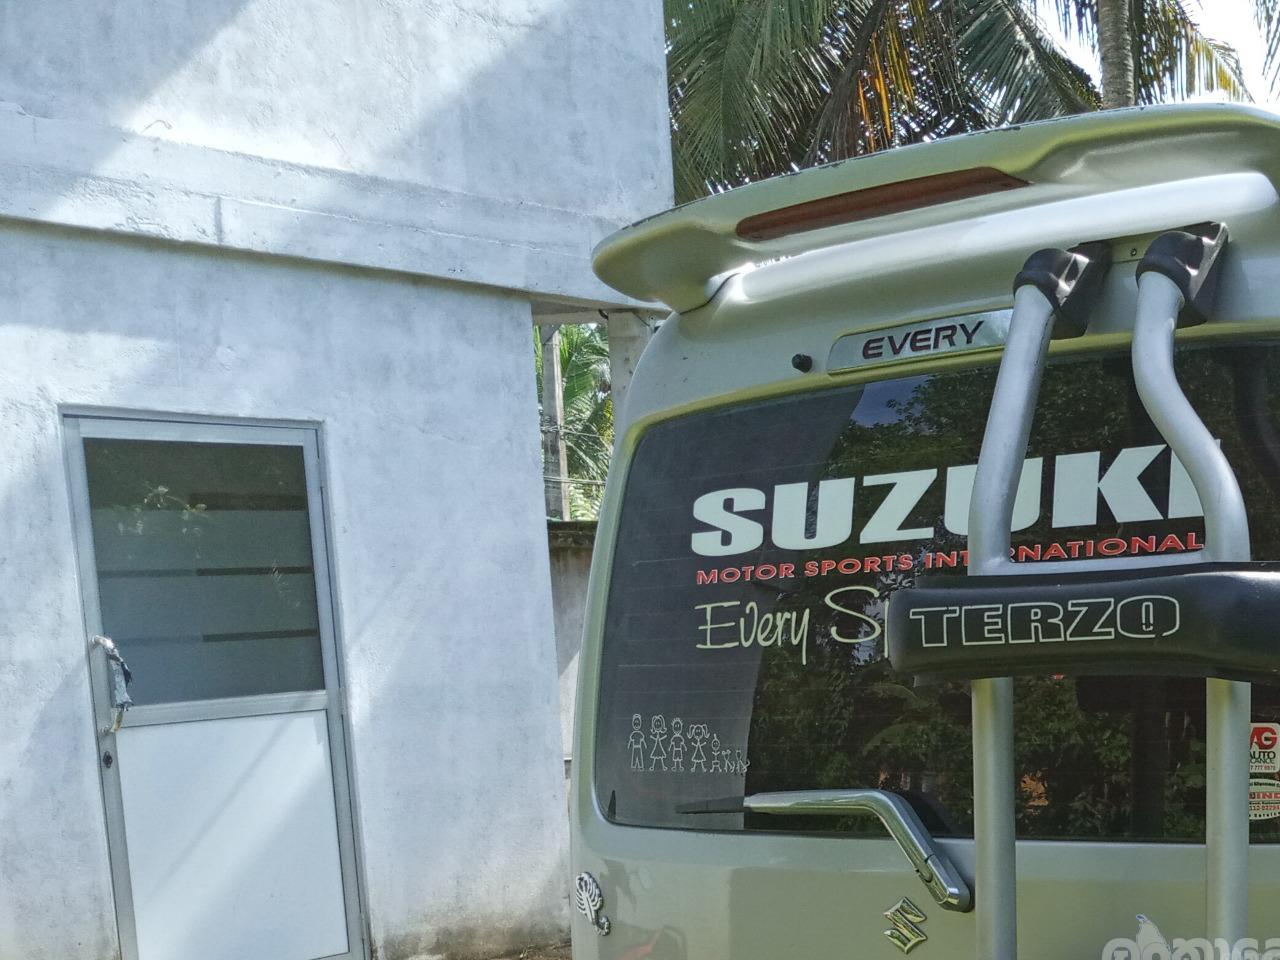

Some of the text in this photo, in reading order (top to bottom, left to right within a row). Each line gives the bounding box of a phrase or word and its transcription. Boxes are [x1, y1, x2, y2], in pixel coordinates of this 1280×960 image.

[862, 320, 985, 359] EVERY
[696, 532, 1205, 585] MOTOR SPORTS INTNATIONAL
[694, 600, 810, 666] Every
[909, 595, 1180, 648] TERZO
